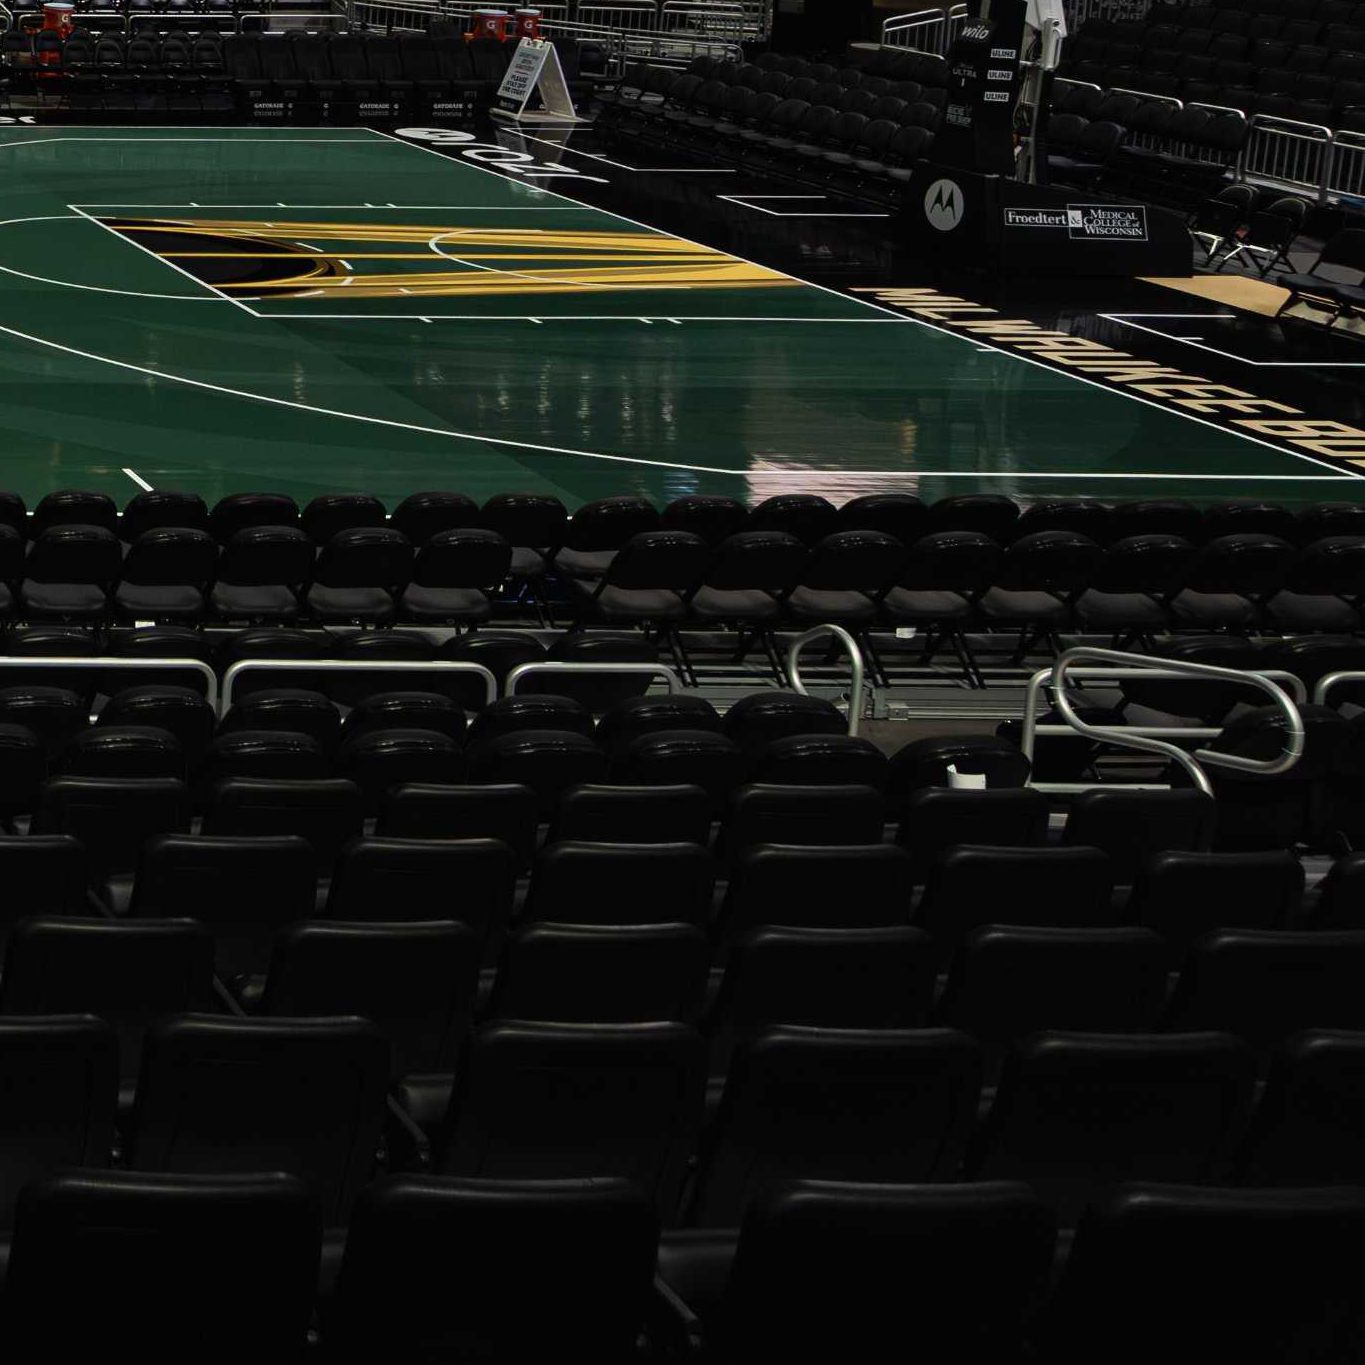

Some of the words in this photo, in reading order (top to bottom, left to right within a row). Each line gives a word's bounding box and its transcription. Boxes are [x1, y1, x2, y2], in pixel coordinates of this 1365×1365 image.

[962, 24, 989, 39] wilo
[1007, 211, 1067, 225] Froedtert
[1090, 209, 1139, 221] MEDICAL
[1083, 217, 1133, 228] COLLEGE
[1084, 225, 1143, 236] WISCONSIN
[848, 287, 1306, 414] MILWAUKEE
